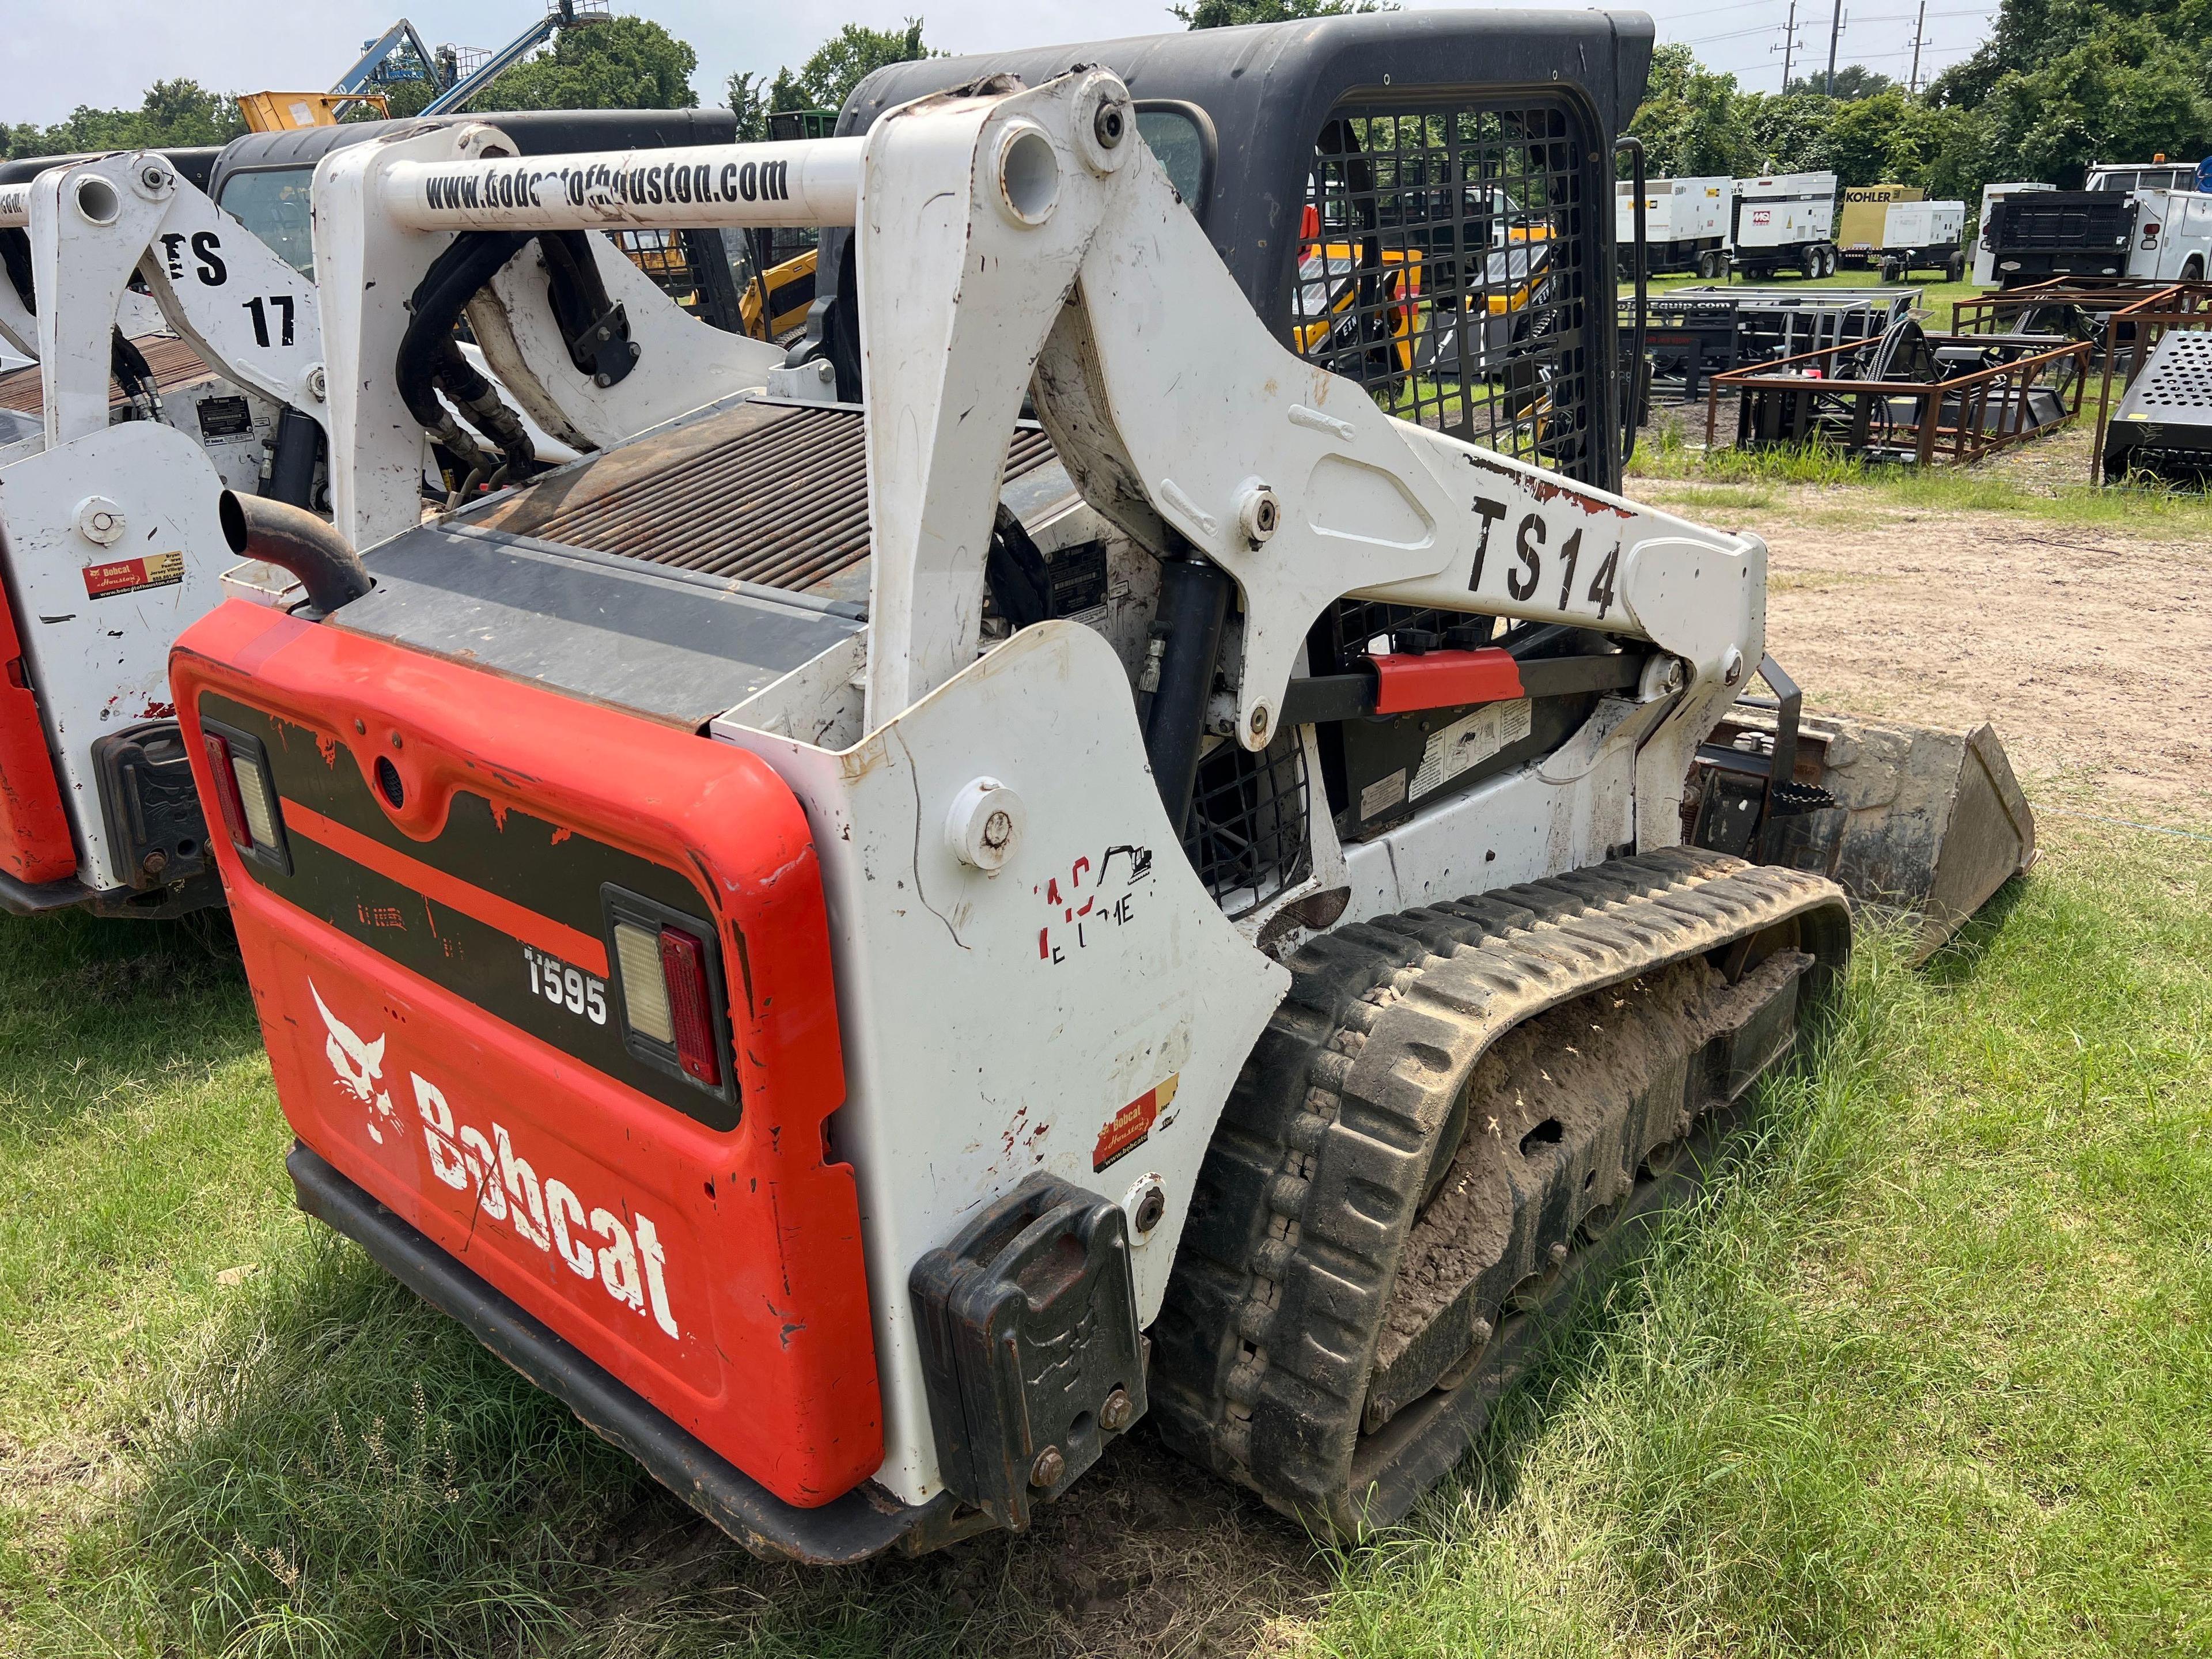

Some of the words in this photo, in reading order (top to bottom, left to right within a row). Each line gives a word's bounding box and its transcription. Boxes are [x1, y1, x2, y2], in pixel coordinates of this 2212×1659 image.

[1846, 191, 1891, 203] KOHLER
[242, 295, 294, 348] 17
[103, 565, 131, 577] Bobcat
[1468, 495, 1621, 620] TS14
[1113, 1104, 1141, 1132] Bobcat
[410, 1070, 679, 1340] Bobcat
